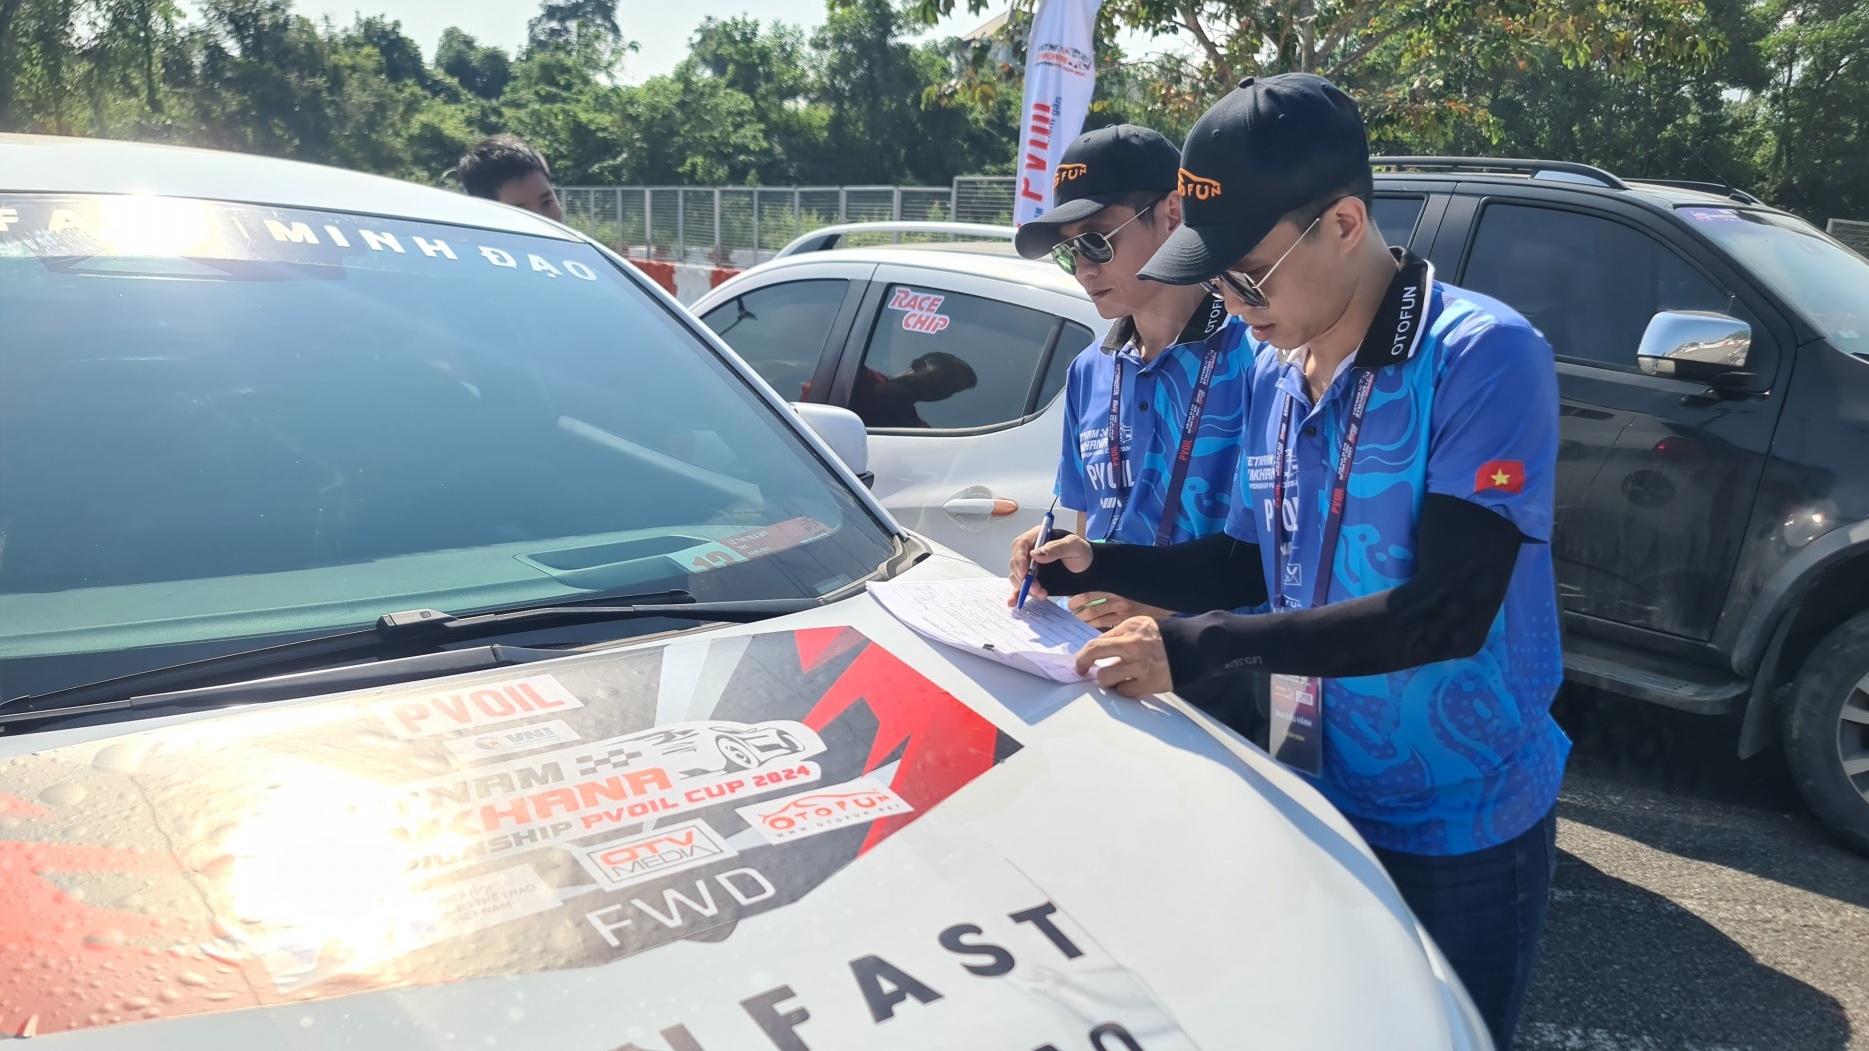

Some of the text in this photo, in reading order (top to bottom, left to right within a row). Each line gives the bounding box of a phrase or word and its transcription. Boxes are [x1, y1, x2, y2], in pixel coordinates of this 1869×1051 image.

[263, 219, 460, 261] MINH
[479, 245, 598, 282] ĐẠO
[889, 288, 943, 313] RACE
[1204, 298, 1224, 334] OTOF
[903, 313, 949, 332] CHIP
[1390, 286, 1418, 357] OTOFUN
[1178, 439, 1193, 462] PVOIL
[1330, 487, 1345, 515] PVOIL
[394, 682, 566, 733] PVOIL
[580, 797, 679, 830] PVOIL
[684, 779, 746, 805] CUP
[752, 764, 811, 788] 2024
[768, 793, 892, 830] OTOFUN
[600, 830, 696, 867] OTV
[610, 843, 710, 878] MEDIA
[583, 866, 777, 948] FWD
